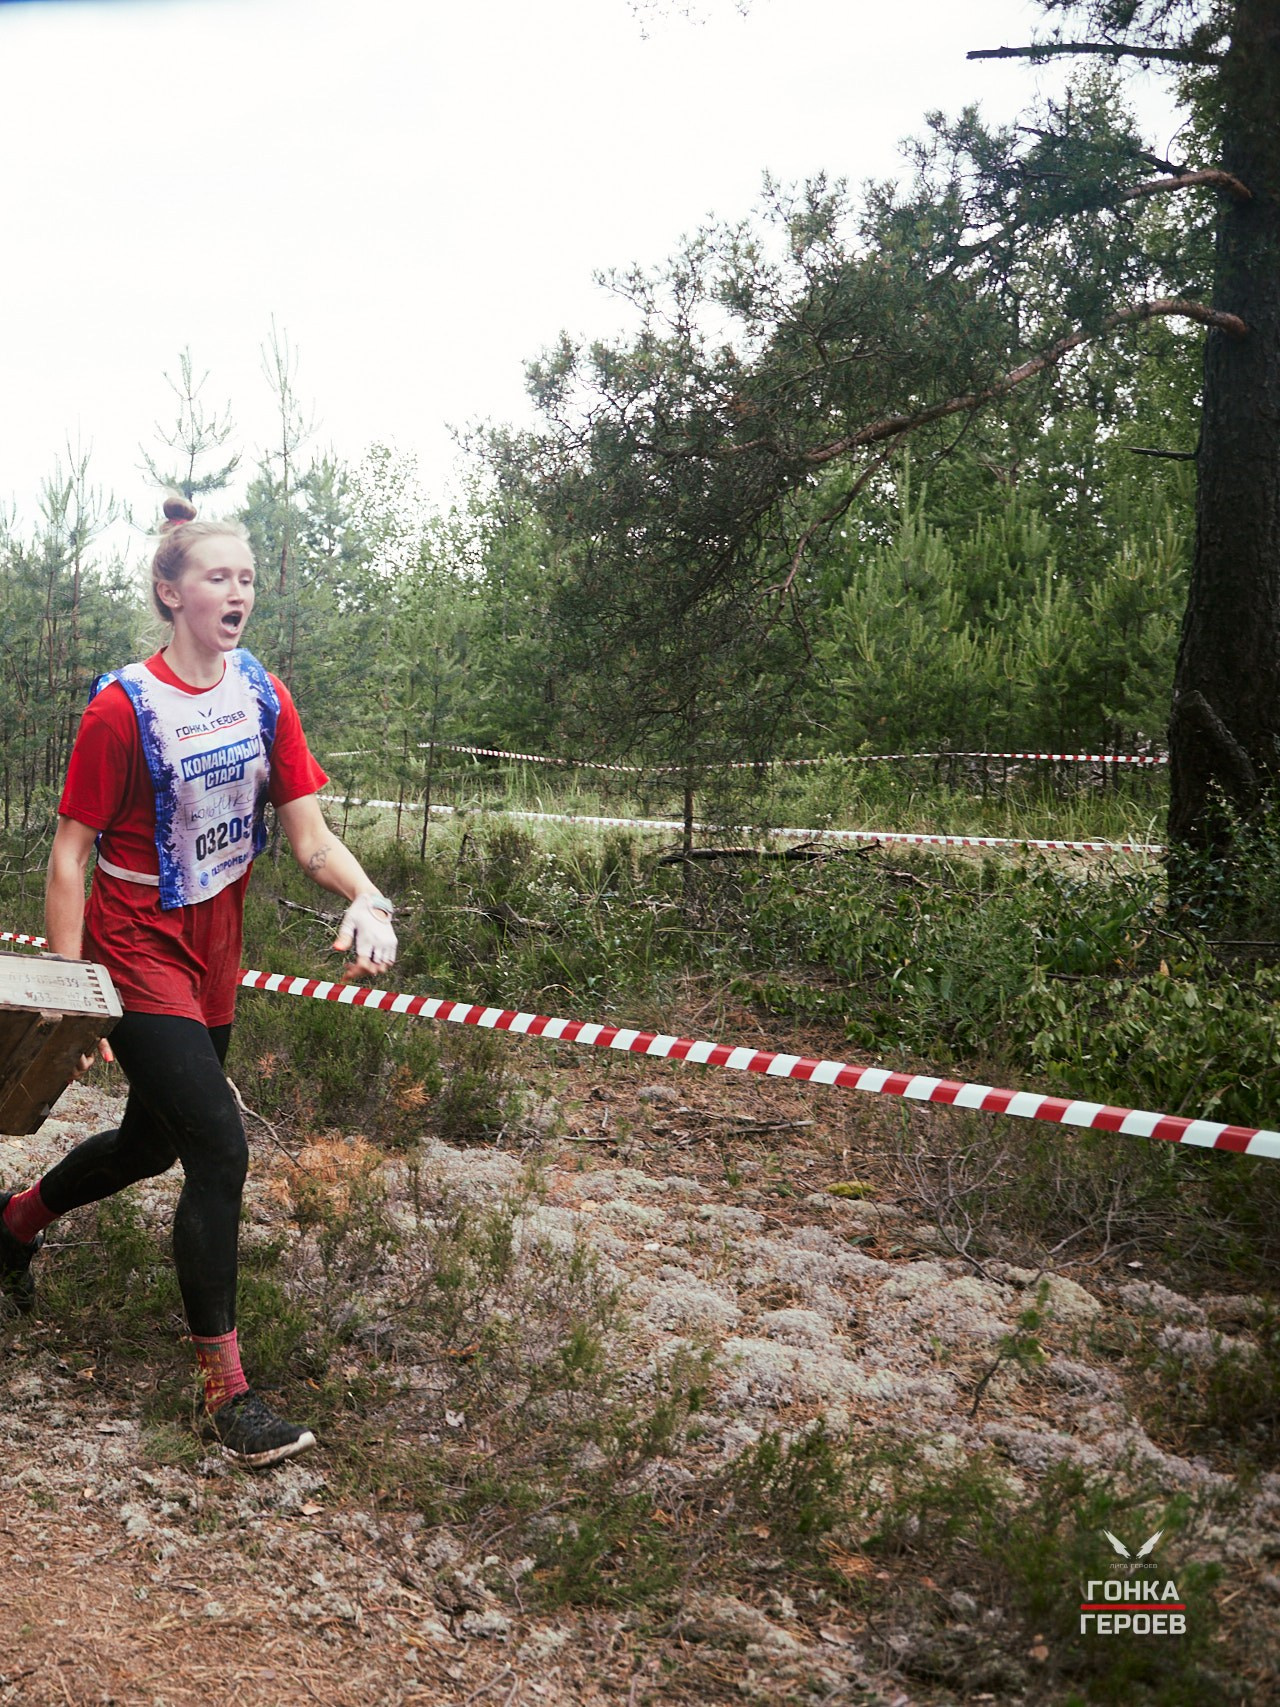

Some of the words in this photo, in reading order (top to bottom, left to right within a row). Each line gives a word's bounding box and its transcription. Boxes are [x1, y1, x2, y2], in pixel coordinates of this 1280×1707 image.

[175, 723, 209, 738] ГОНКА
[210, 710, 246, 729] ГЕРОЕВ
[183, 735, 260, 778] КОМАНДНЫЙ
[206, 764, 242, 788] СТАРТ
